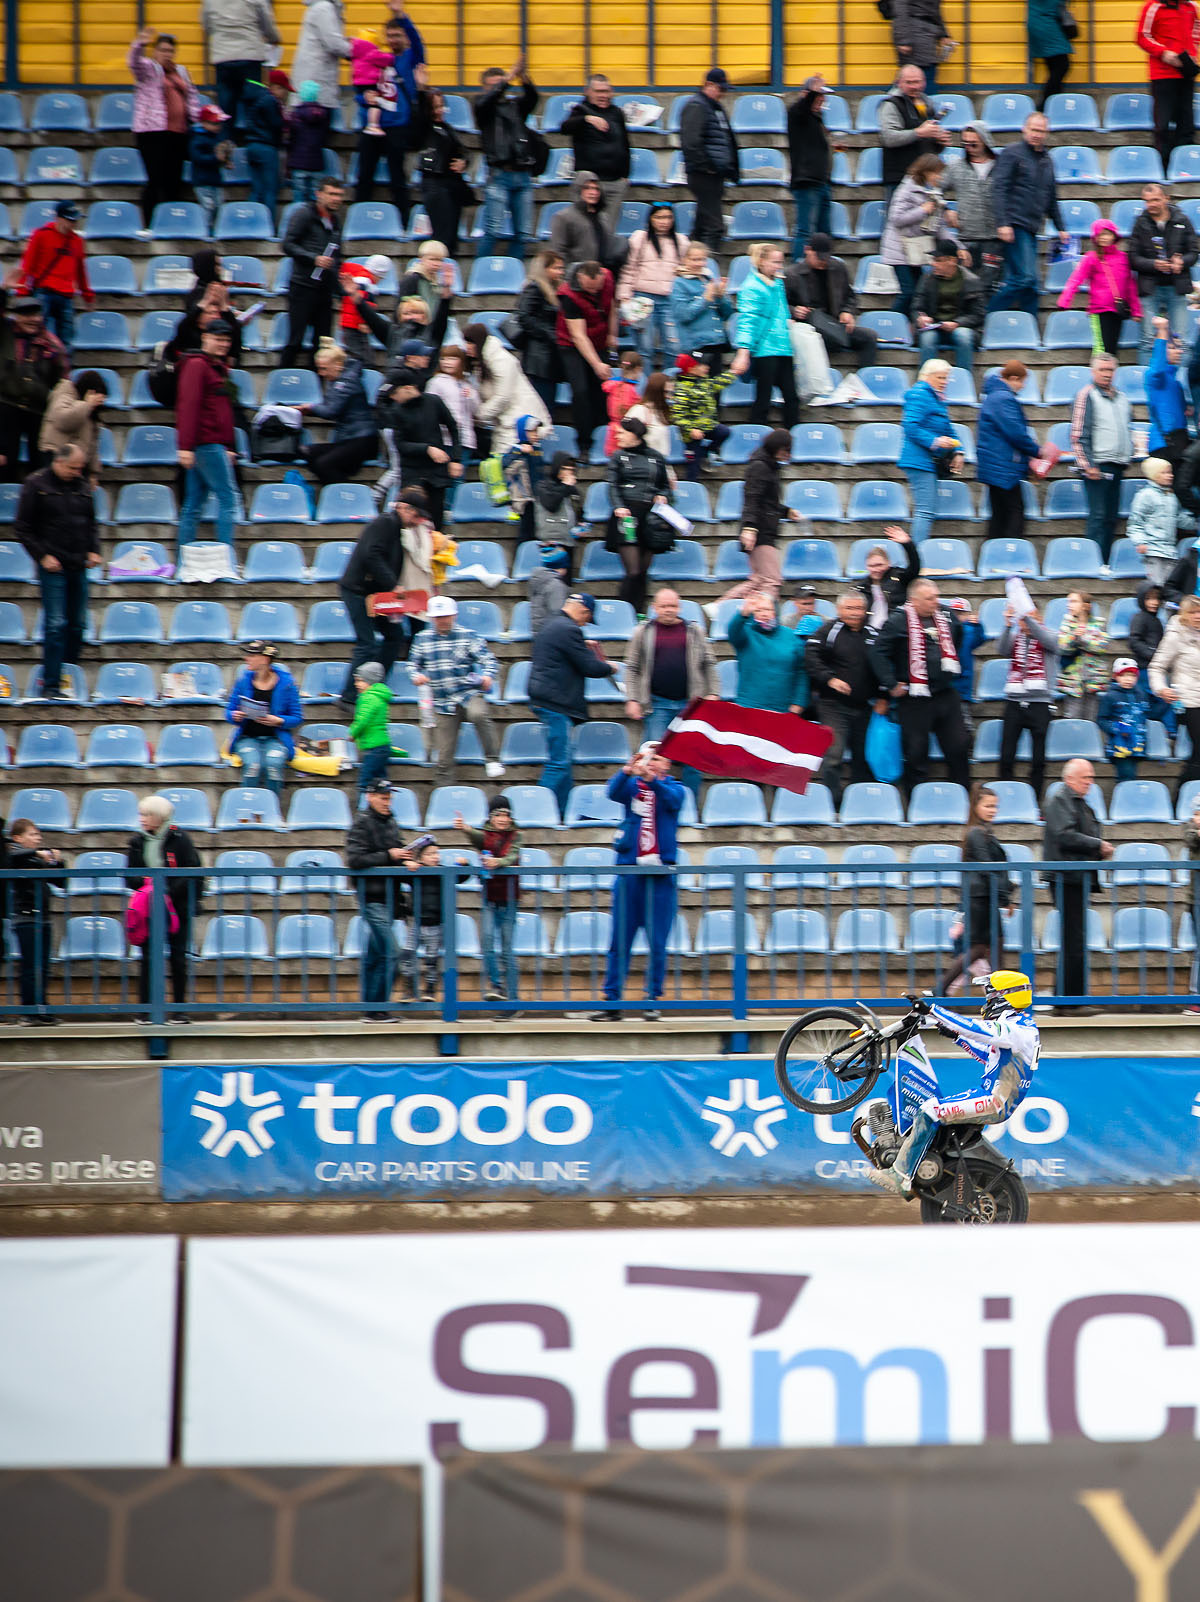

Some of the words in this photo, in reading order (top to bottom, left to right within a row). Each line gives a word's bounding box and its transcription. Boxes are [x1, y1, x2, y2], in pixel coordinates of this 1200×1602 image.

[299, 1080, 593, 1146] trodo
[0, 1126, 43, 1148] va
[51, 1154, 156, 1185] prakse
[314, 1161, 377, 1181] CAR
[382, 1161, 477, 1181] PARTS
[481, 1161, 591, 1181] ONLINE
